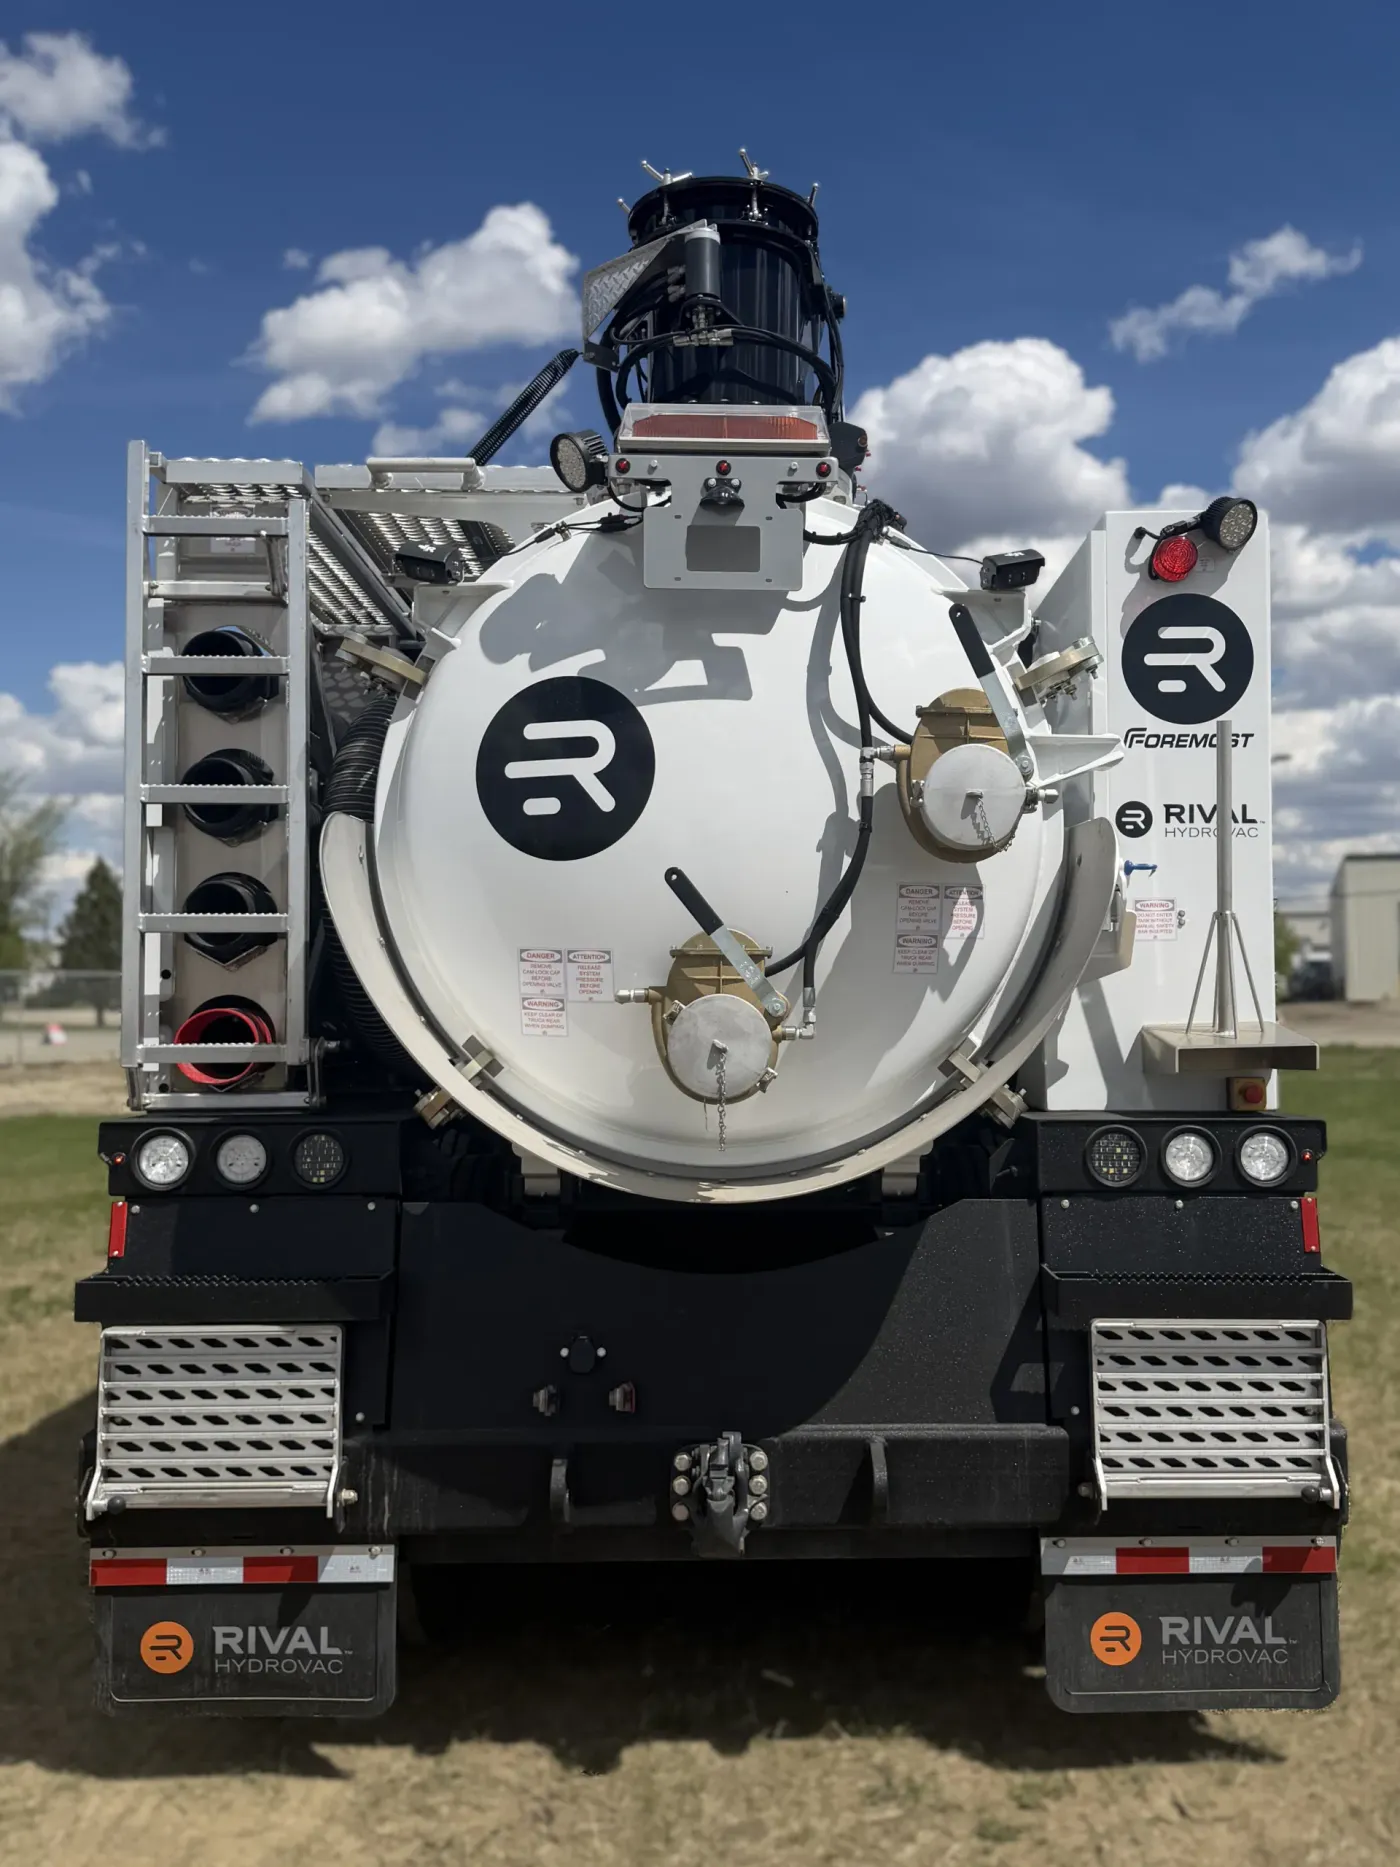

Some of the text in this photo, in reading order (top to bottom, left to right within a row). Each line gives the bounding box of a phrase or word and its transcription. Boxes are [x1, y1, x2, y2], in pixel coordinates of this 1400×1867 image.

[1165, 827, 1259, 838] HYDRAC
[1159, 1616, 1287, 1645] RIVAL
[212, 1626, 343, 1655] RIVAL
[1162, 1649, 1288, 1665] HYDROVAC
[215, 1659, 343, 1674] HYDROVAC
